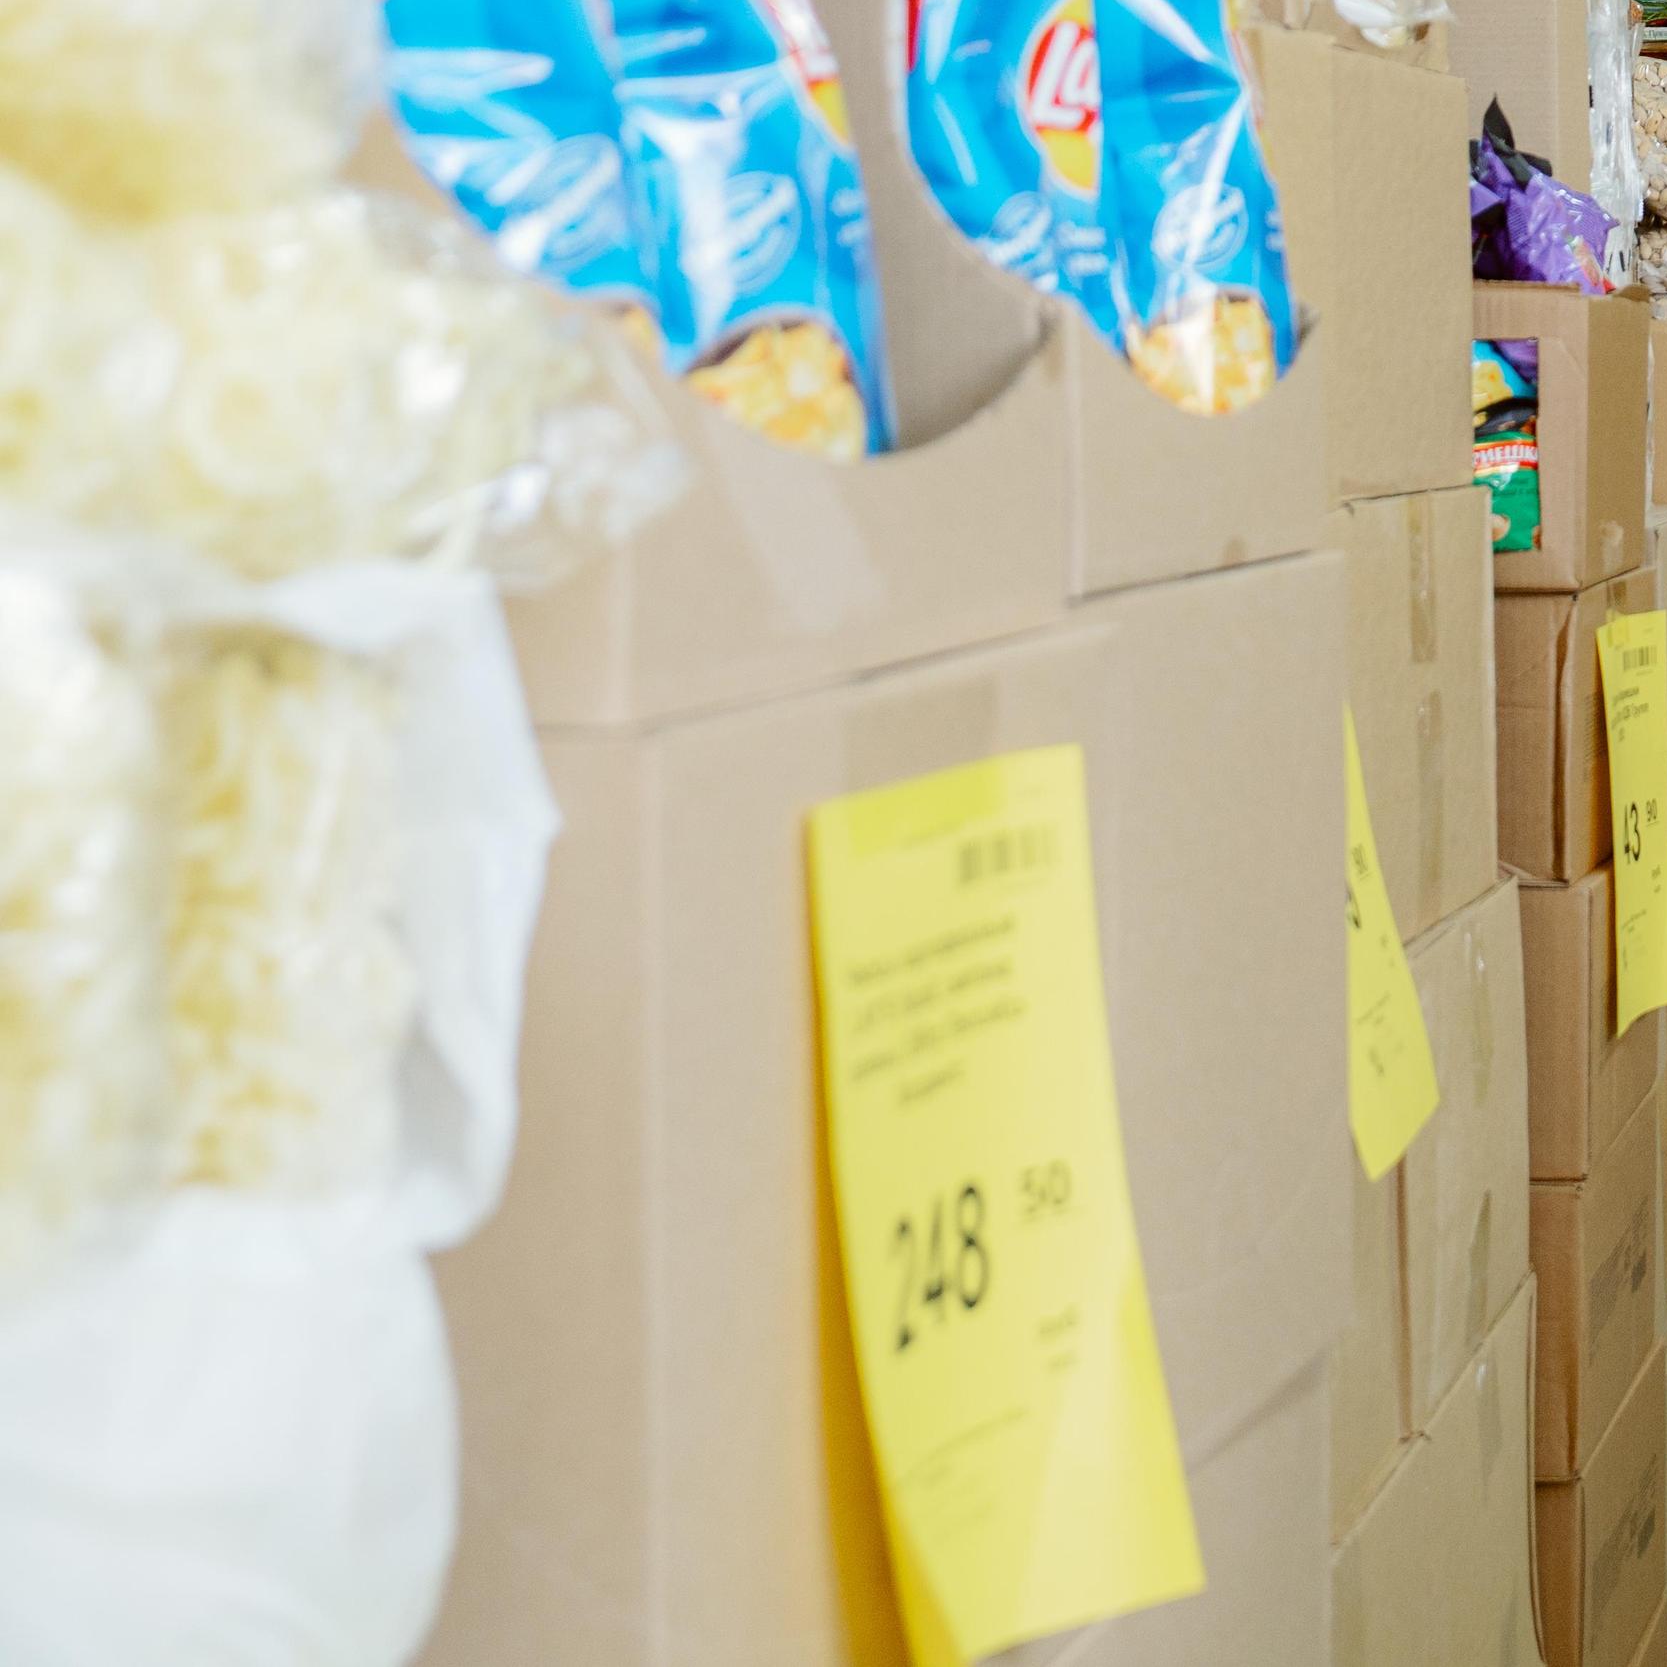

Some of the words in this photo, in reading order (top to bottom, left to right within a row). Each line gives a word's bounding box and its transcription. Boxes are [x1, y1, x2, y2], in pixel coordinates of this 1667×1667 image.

[1623, 801, 1640, 864] 43
[888, 1184, 991, 1354] 248
[1020, 1160, 1073, 1218] 50
